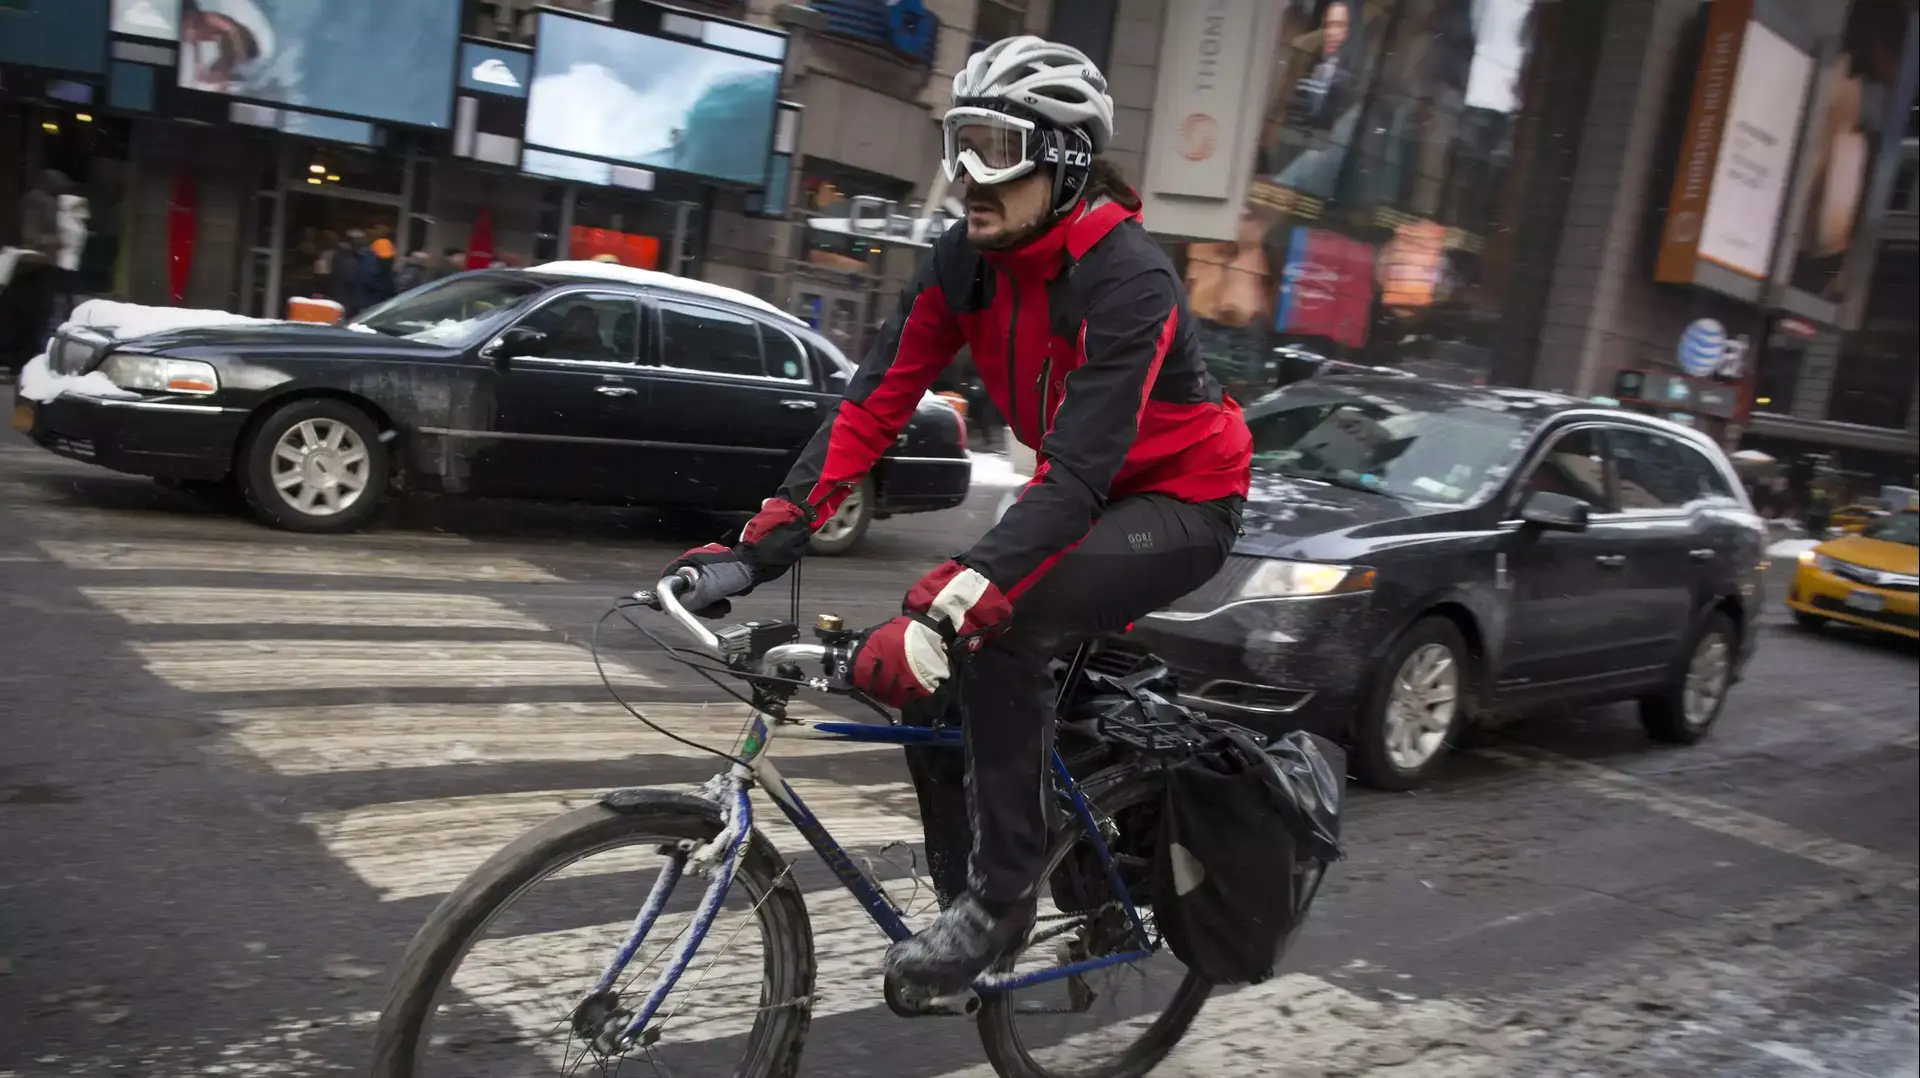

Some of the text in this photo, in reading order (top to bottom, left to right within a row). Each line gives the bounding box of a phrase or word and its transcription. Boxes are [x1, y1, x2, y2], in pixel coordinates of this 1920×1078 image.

[1193, 0, 1226, 93] THOM
[1045, 147, 1092, 166] SCO
[1127, 532, 1152, 544] GORE
